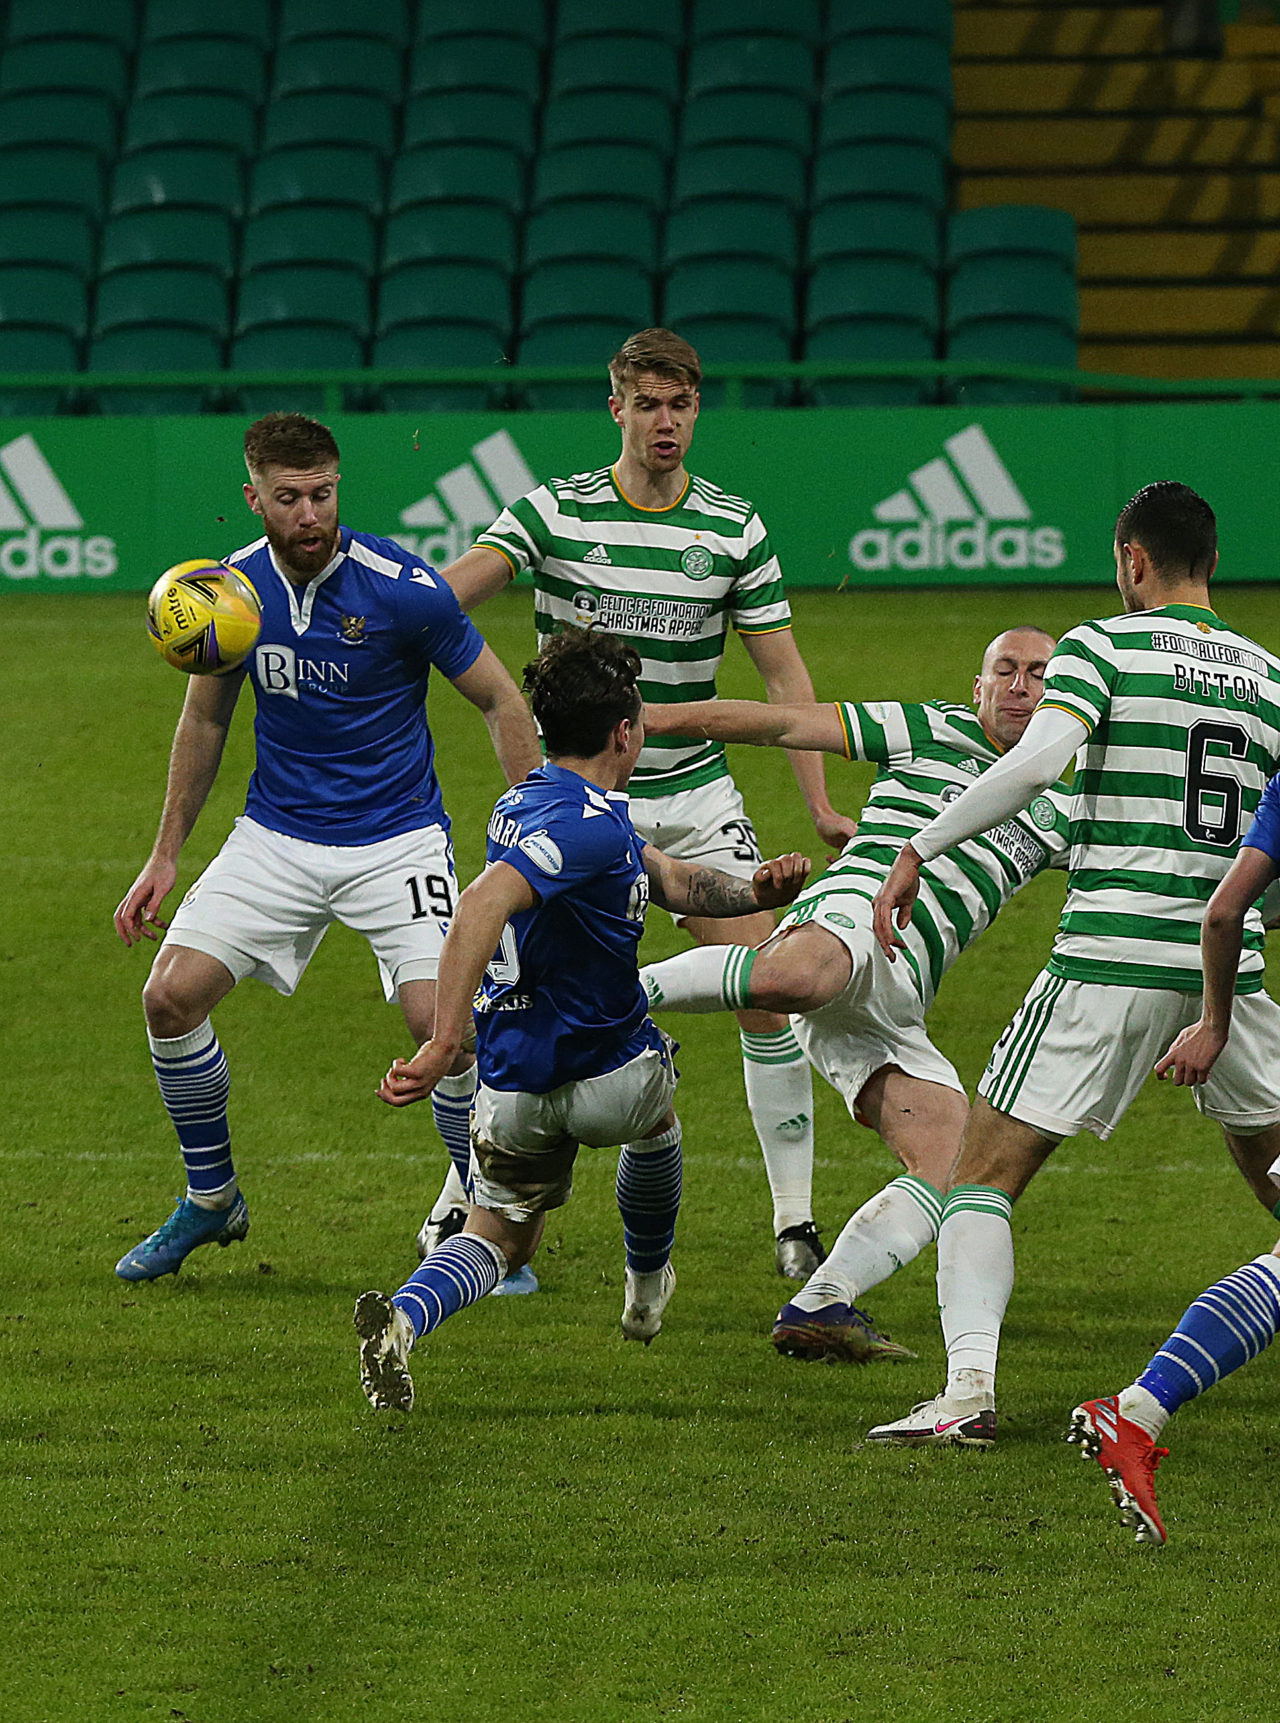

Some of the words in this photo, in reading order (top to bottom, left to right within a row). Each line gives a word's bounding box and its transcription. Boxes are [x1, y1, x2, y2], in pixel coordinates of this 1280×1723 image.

[850, 518, 1066, 571] adidas
[167, 587, 190, 630] mitre
[600, 595, 635, 613] CELTIC
[636, 598, 650, 614] FC
[600, 611, 667, 634] CHRISTMAS
[261, 651, 350, 690] BINN
[1173, 663, 1259, 704] BITTON
[1183, 718, 1250, 847] 6
[405, 875, 453, 920] 19
